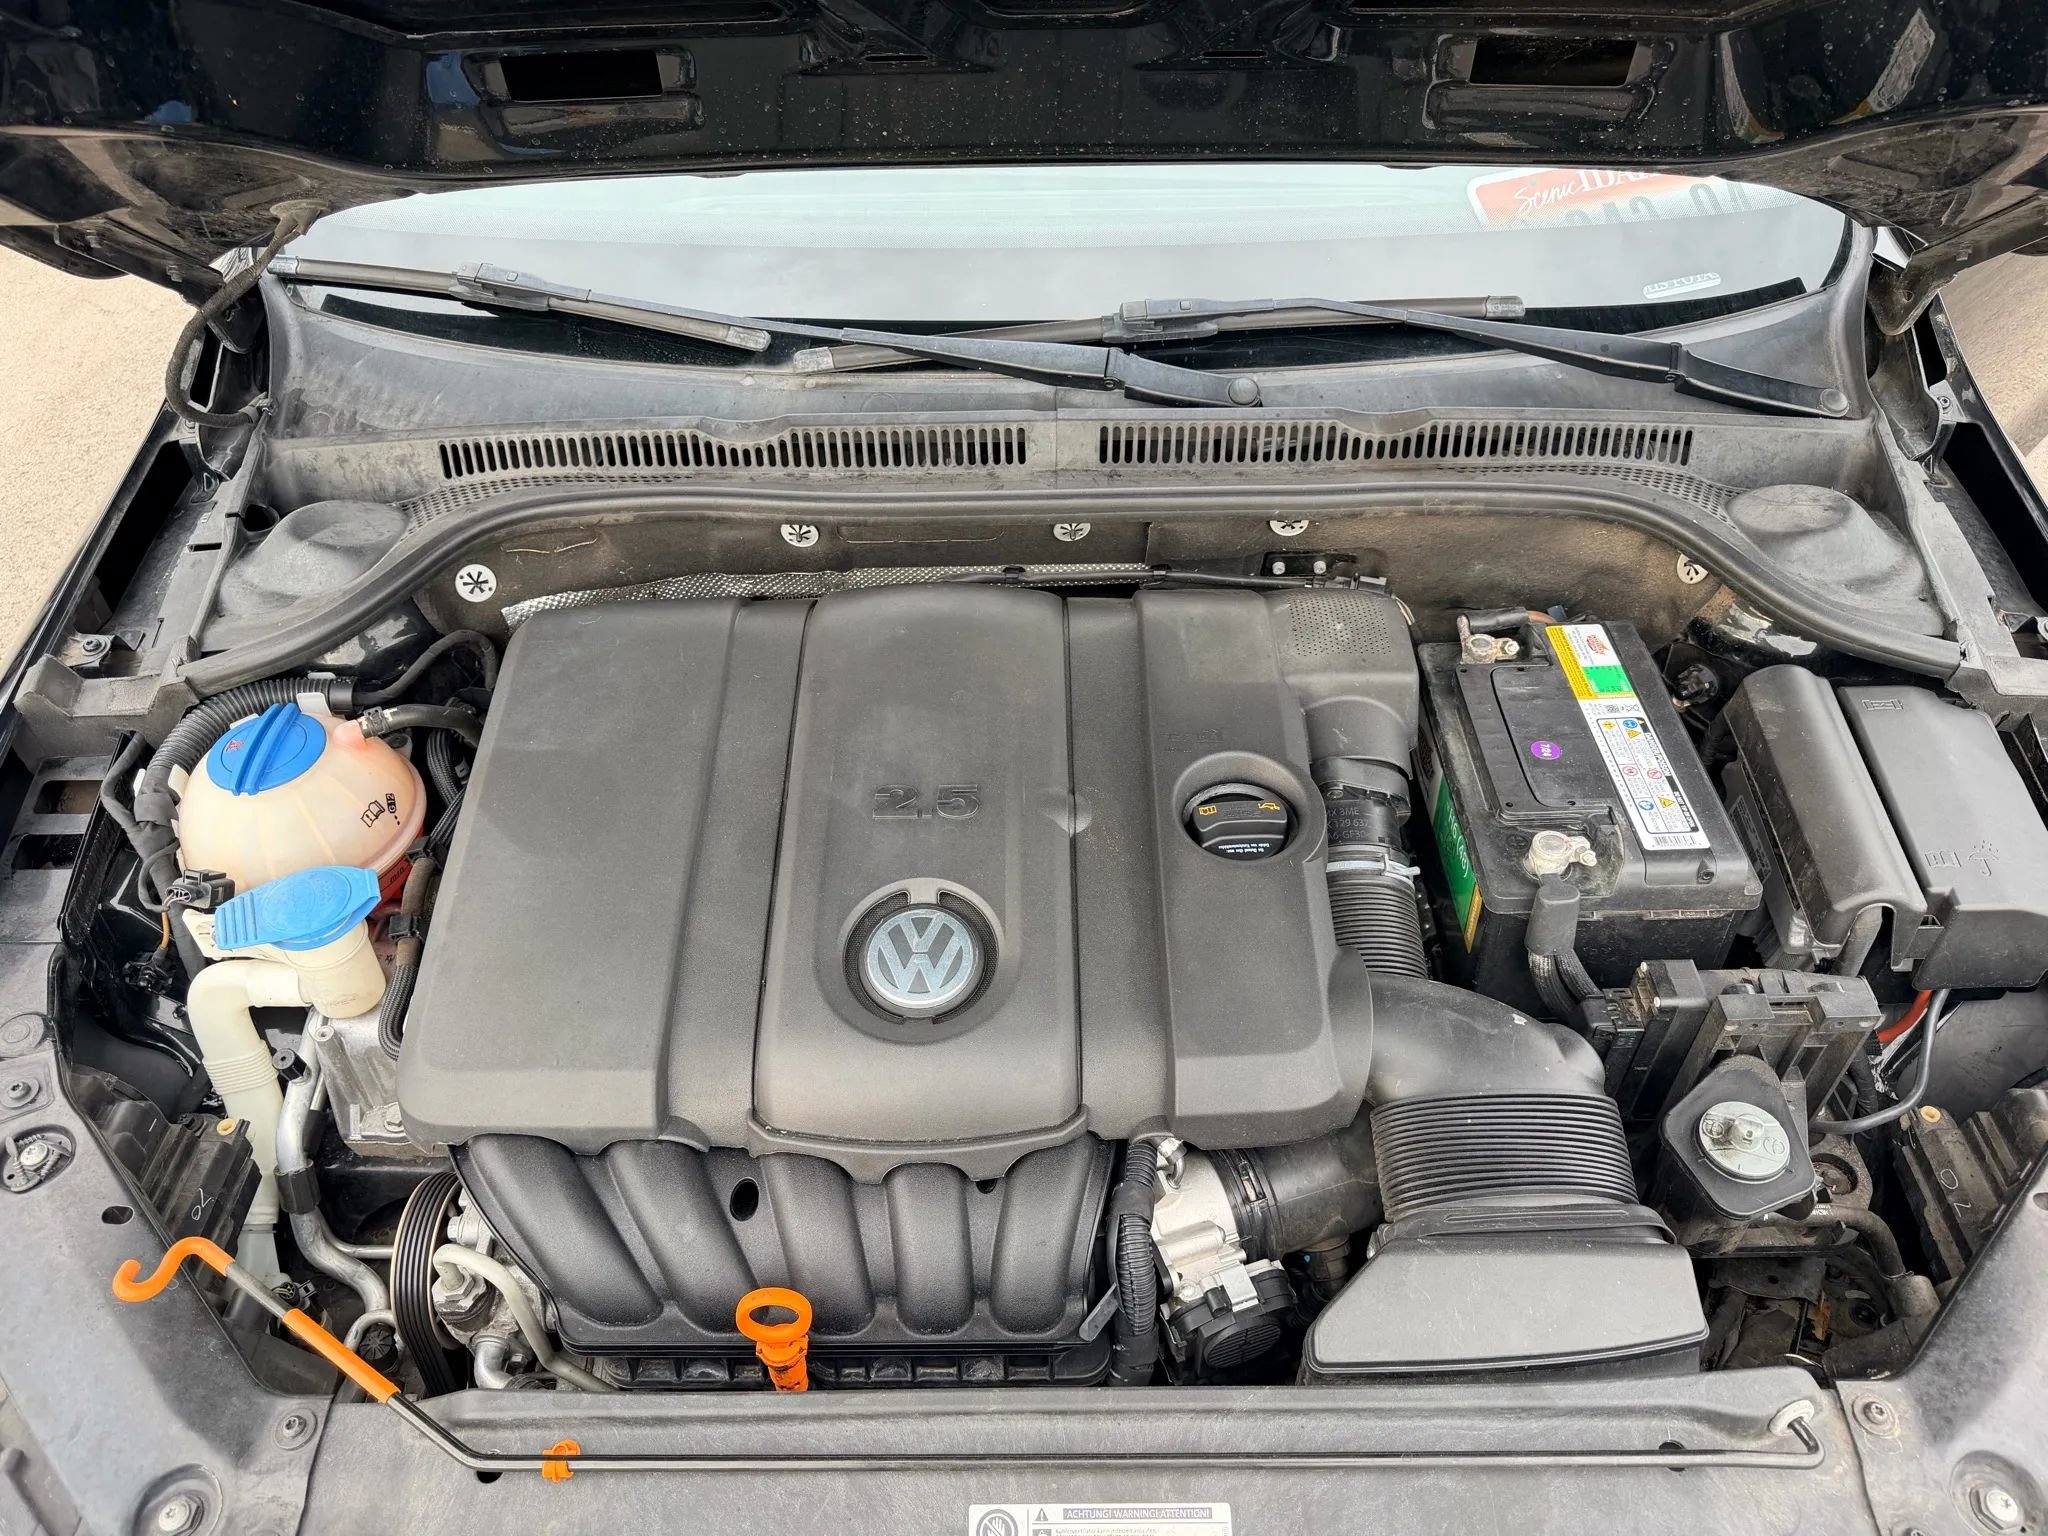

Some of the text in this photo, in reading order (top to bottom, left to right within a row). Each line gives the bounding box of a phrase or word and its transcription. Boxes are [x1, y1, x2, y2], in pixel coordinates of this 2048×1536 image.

[1514, 180, 1581, 216] Scenic
[1574, 170, 1660, 192] IDA
[386, 793, 397, 813] G12
[872, 784, 980, 819] 2.5
[1448, 808, 1458, 839] H6
[869, 910, 972, 1006] VW
[1066, 1508, 1210, 1519] ACHTUNG! WARNING! ATTENTION!
